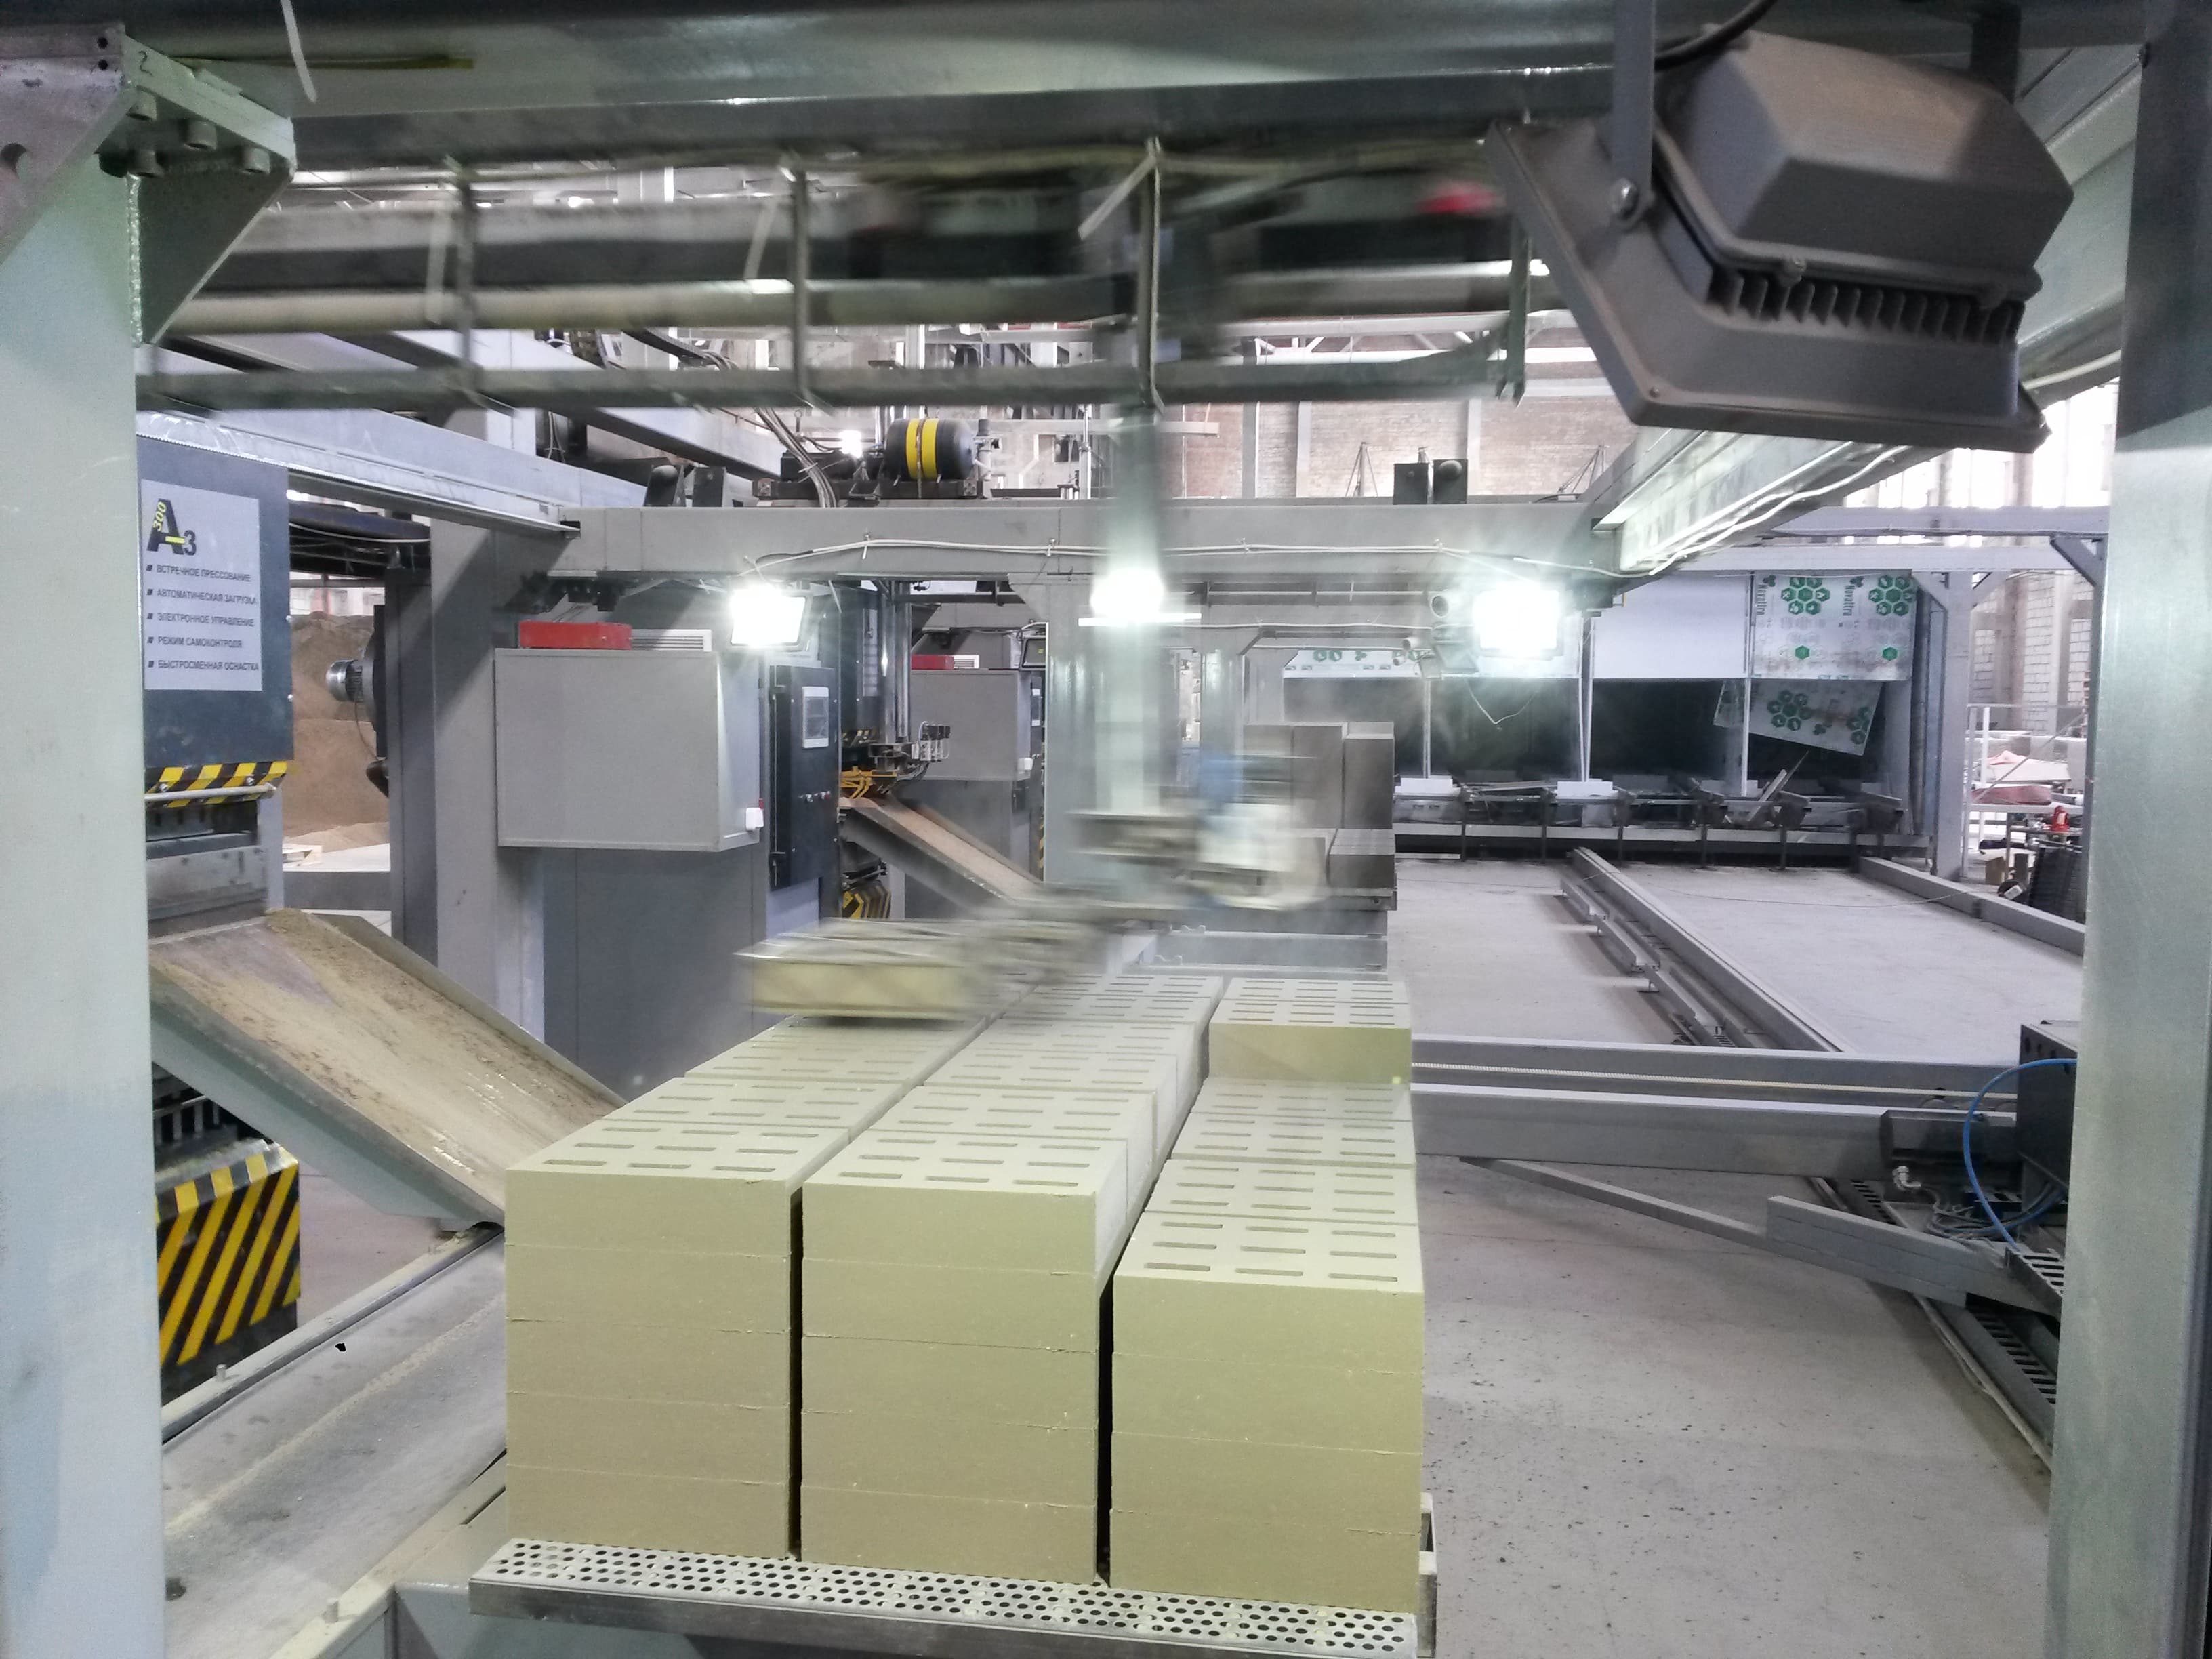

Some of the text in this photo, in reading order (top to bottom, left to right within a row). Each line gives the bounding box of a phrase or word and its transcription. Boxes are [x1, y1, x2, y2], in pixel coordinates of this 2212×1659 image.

[152, 501, 166, 532] 300
[157, 565, 251, 582] ВСТРЕЧНОЕ ПРЕССОВАНИЕ
[157, 589, 257, 605] АВТОМАТИЧЕСКАЯ ЗАГРУЗКА
[157, 613, 255, 627] ЭЛЕКТРОННОЕ УПРАВЛЕНИЕ
[158, 636, 184, 644] РЕЖИМ
[158, 660, 259, 671] БЫСТРОСМЕННАЯ ОСНАСТКА
